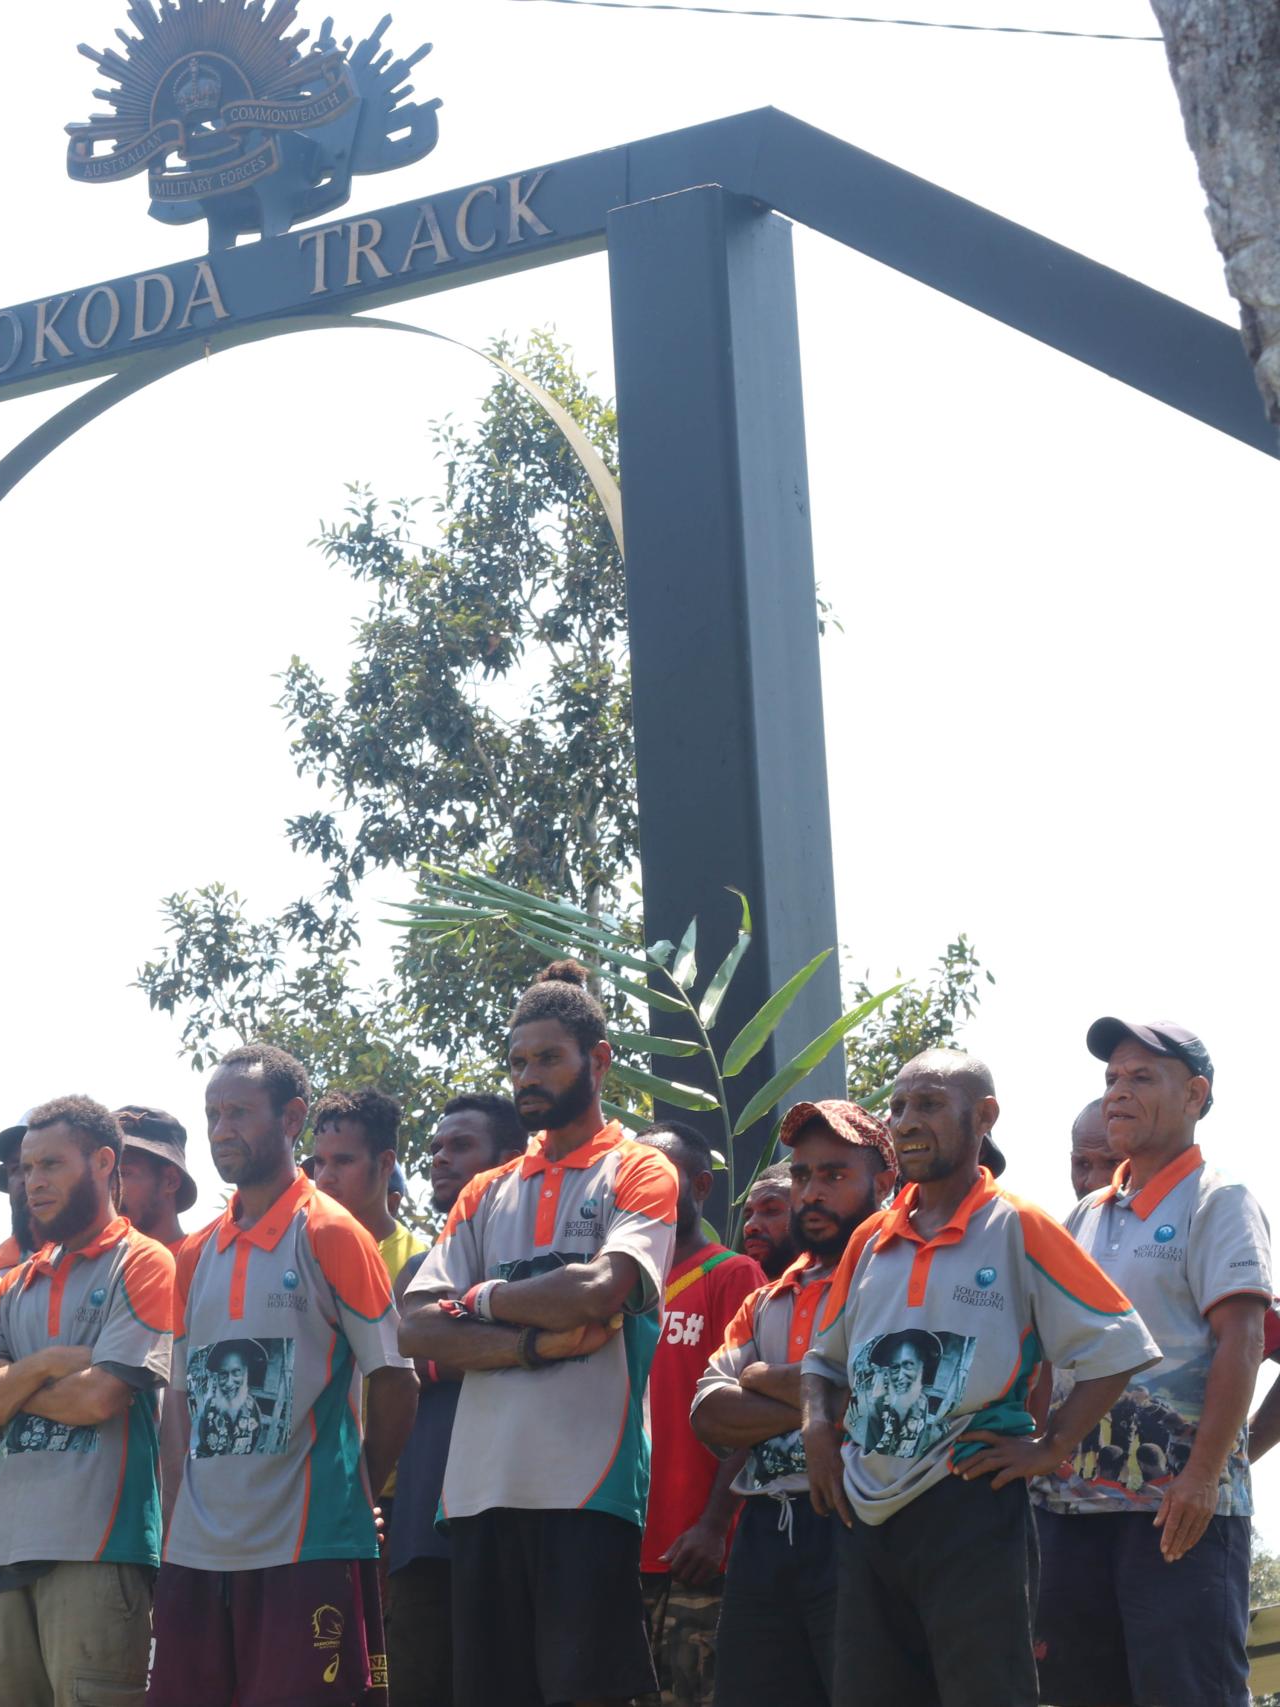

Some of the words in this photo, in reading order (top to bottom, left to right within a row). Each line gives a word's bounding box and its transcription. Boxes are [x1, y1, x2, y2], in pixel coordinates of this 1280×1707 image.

[230, 93, 340, 122] COMMONWEALTH
[83, 131, 163, 177] AUSTRALIAN
[154, 177, 213, 196] MILITARY
[220, 155, 267, 187] FORCES
[298, 168, 558, 297] TRACK
[565, 1220, 593, 1229] SOUTH
[267, 1292, 295, 1301] SOUTH
[952, 1292, 1004, 1311] HORIZONS
[955, 1284, 988, 1299] SOUTH
[990, 1290, 1004, 1303] SEA
